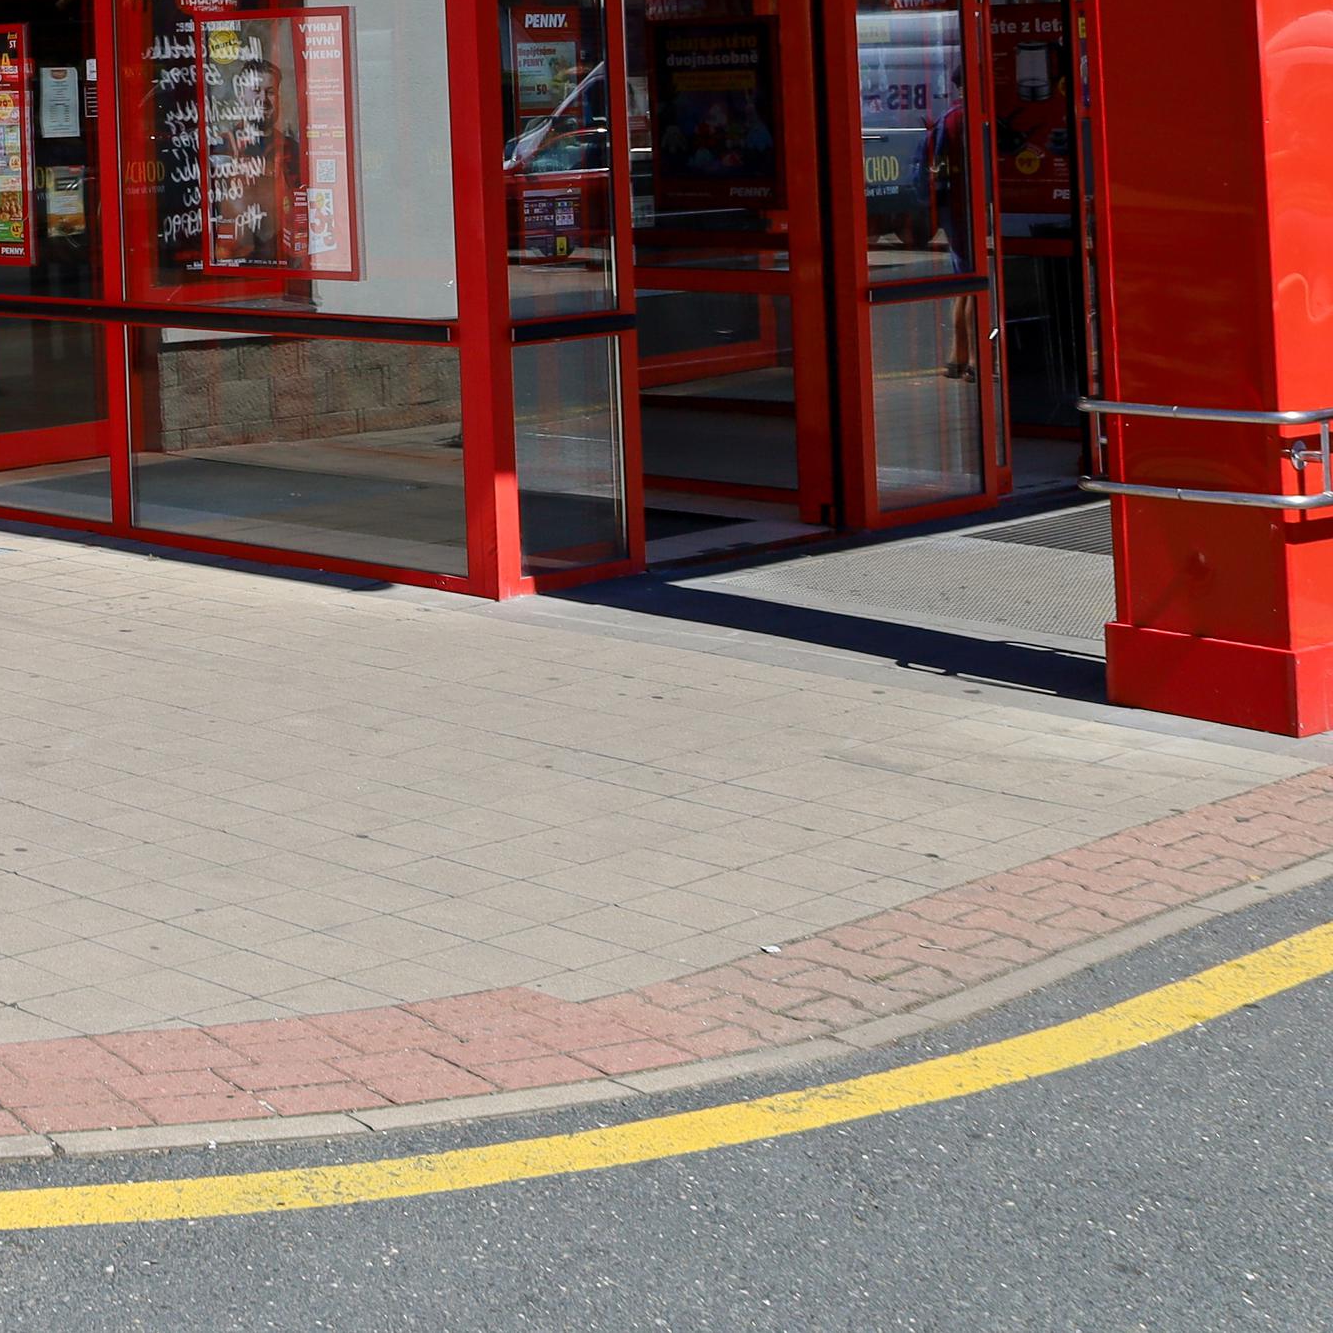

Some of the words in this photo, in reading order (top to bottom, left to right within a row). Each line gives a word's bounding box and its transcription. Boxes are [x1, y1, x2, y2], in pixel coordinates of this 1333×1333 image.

[298, 22, 339, 34] VYHRAJ
[990, 19, 1017, 34] áte
[1021, 21, 1031, 33] z
[305, 34, 335, 46] PIVNÍ
[301, 47, 341, 60] VÍKEND
[666, 49, 759, 68] dvojnásobně
[865, 156, 900, 182] CHOD
